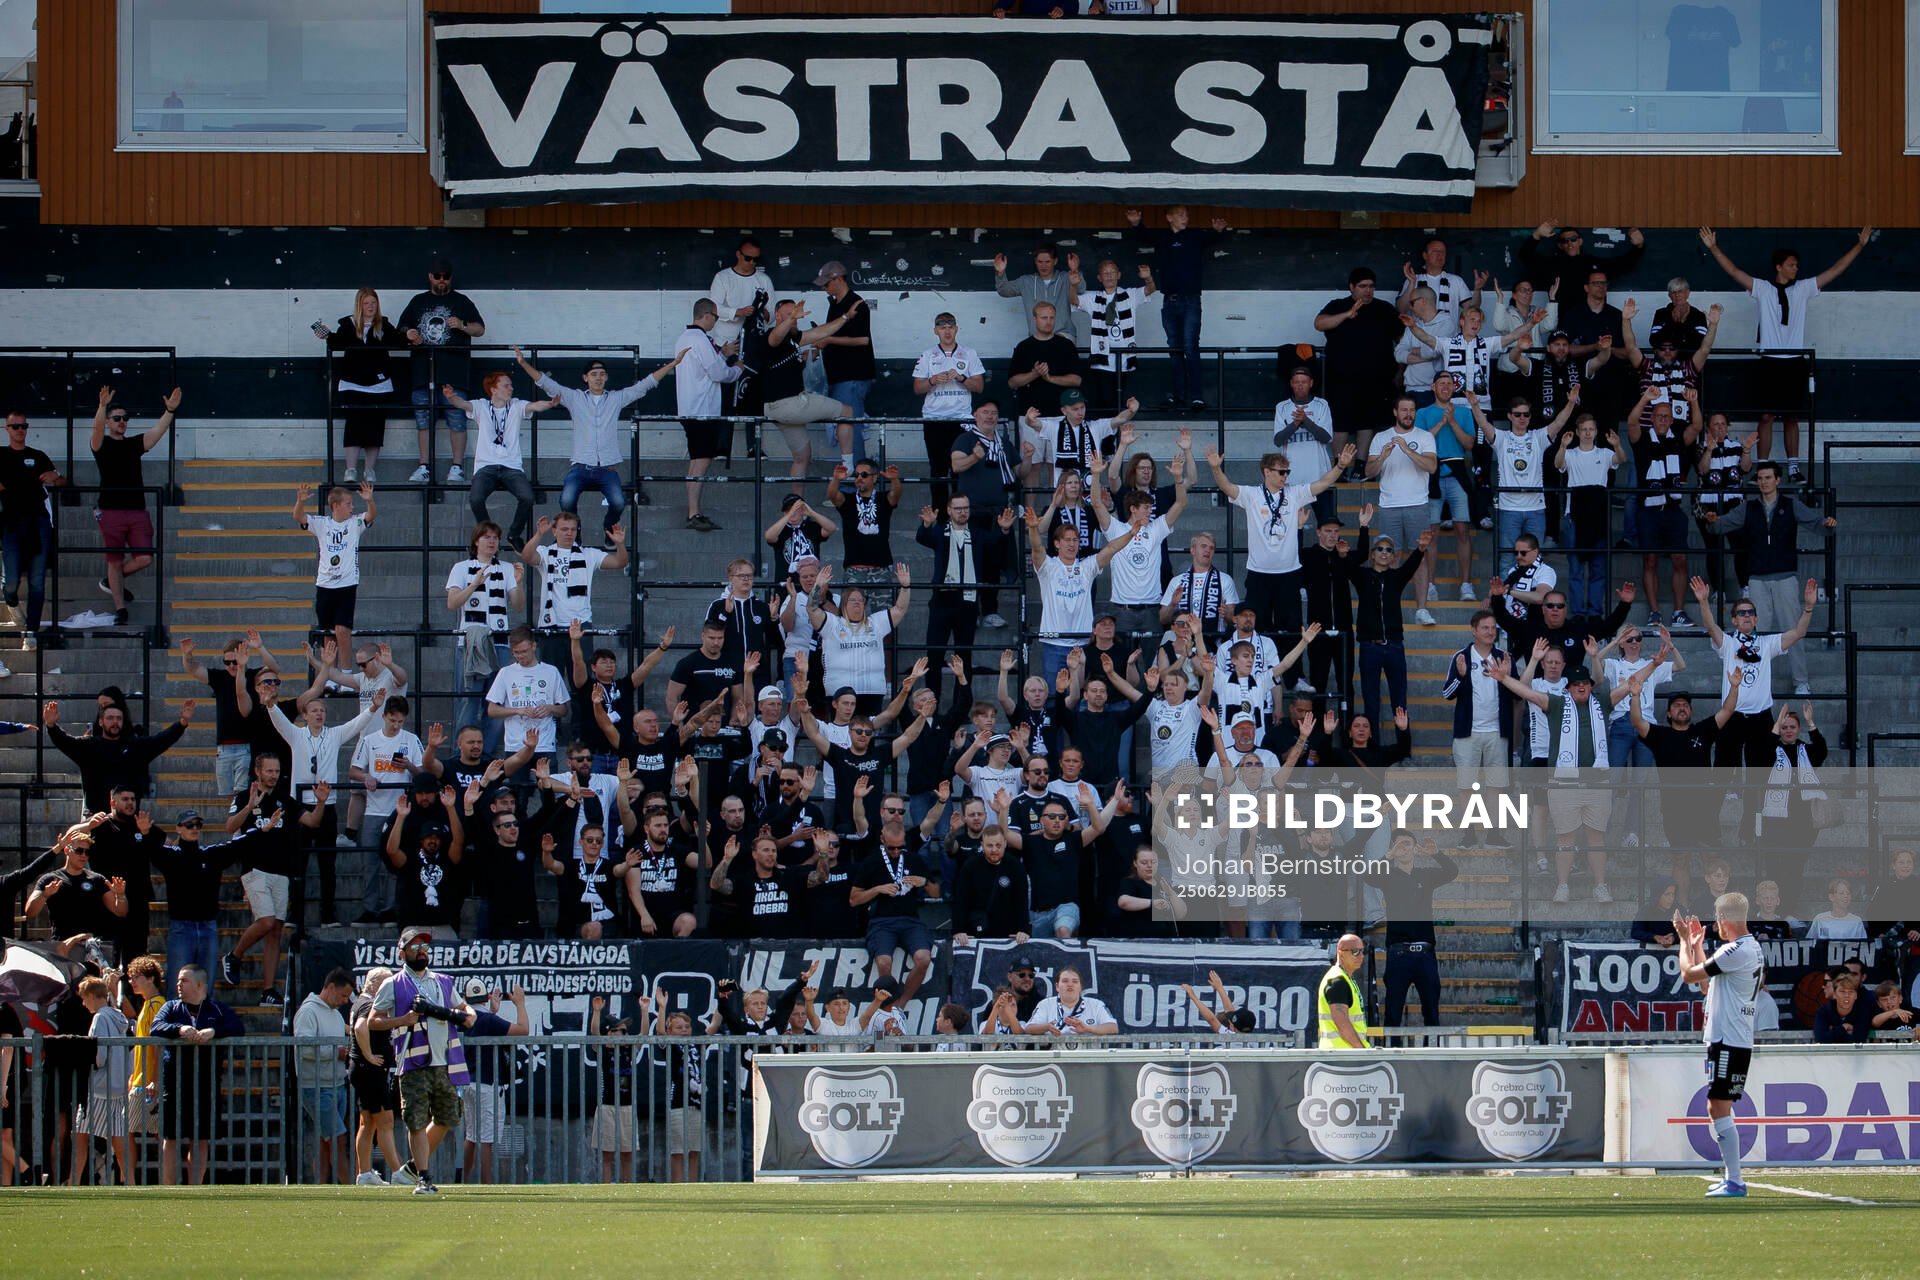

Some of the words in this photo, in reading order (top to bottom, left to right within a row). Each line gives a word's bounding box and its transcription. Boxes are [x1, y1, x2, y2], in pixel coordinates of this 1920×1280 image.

[448, 28, 1131, 168] VÄSTRA
[1170, 20, 1476, 171] STÅ
[354, 945, 373, 966] VI
[375, 945, 456, 966] SJUGER
[459, 940, 494, 967] FÖR
[497, 944, 520, 966] DE
[522, 940, 631, 966] AVSTÄNGDA
[1828, 940, 1876, 968] DEN
[1123, 973, 1310, 1032] ÖREBRO
[858, 1088, 878, 1099] City
[1026, 1086, 1047, 1098] City
[1190, 1084, 1210, 1096] City
[1358, 1083, 1378, 1095] City
[1525, 1082, 1546, 1093] City
[802, 1102, 901, 1132] GOLF
[971, 1100, 1069, 1130] GOLF
[1135, 1098, 1233, 1129] GOLF
[1301, 1097, 1401, 1128] GOLF
[1469, 1095, 1568, 1126] GOLF
[1360, 1131, 1377, 1139] Club
[1528, 1129, 1545, 1137] Club
